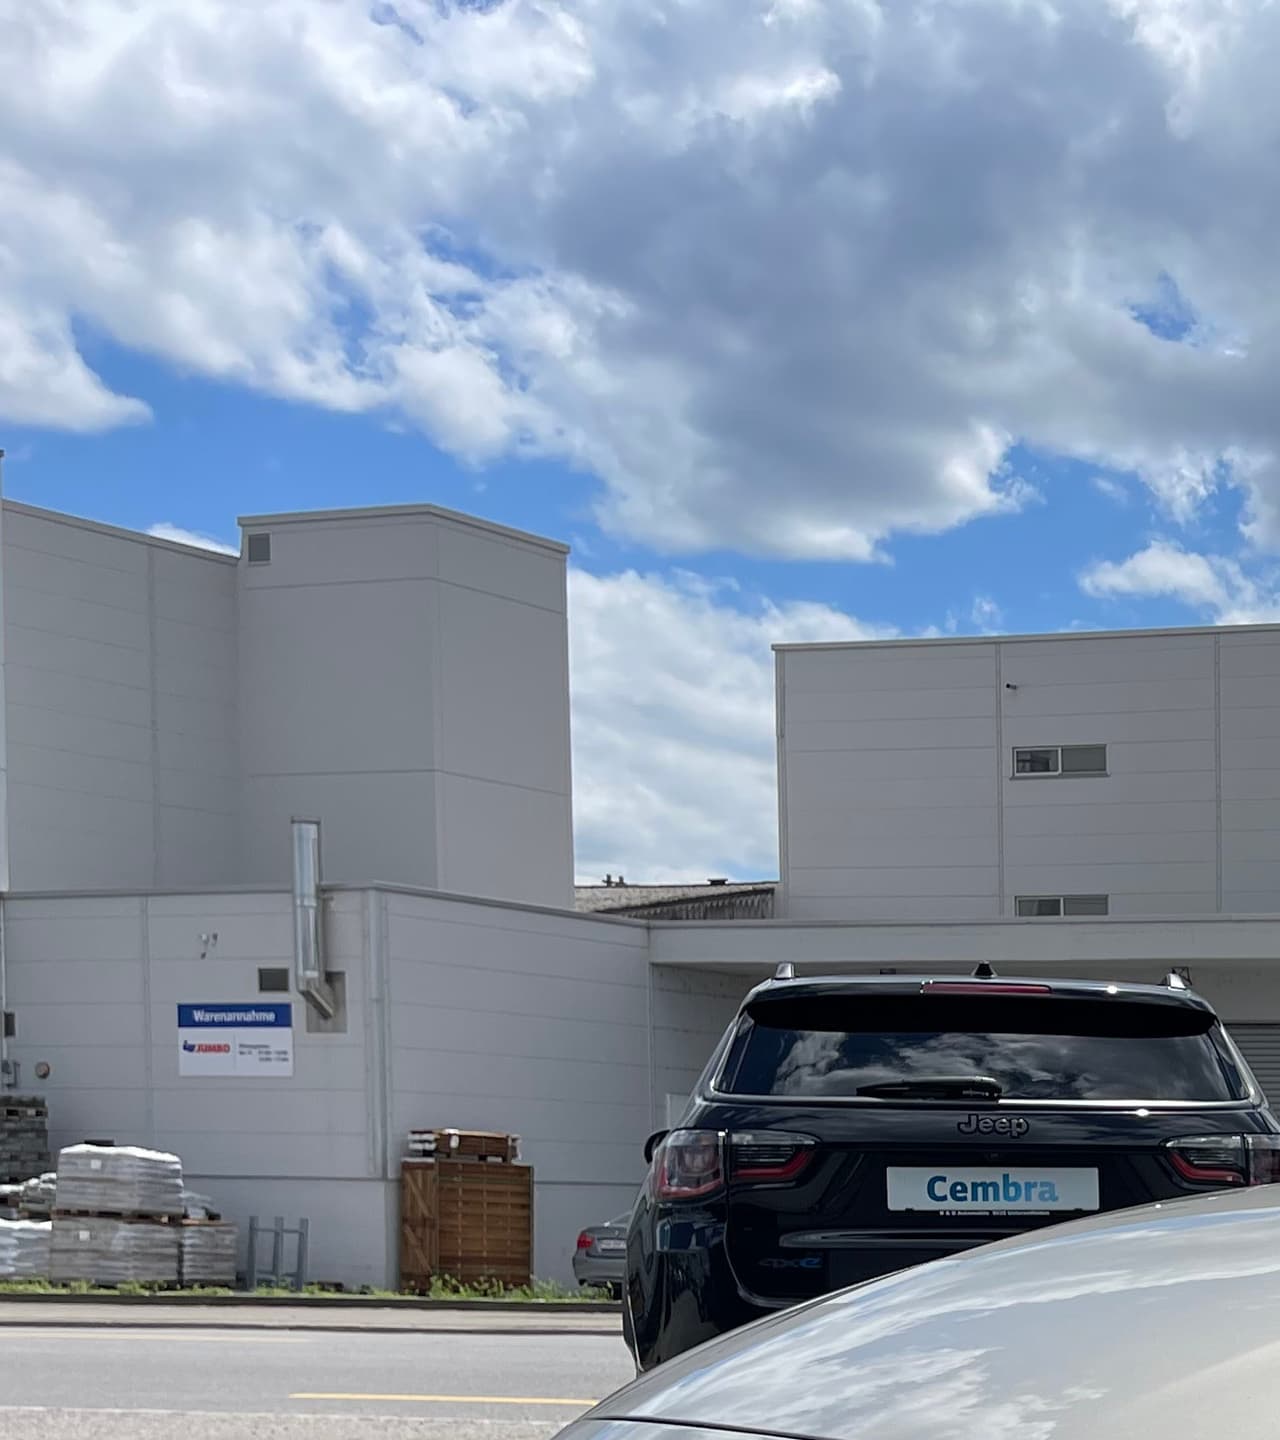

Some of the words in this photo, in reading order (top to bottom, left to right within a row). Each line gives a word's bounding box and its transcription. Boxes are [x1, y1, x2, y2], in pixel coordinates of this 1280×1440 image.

[193, 1009, 276, 1022] Warenannahme
[958, 1114, 1029, 1137] Jeep
[926, 1173, 1059, 1203] Cembra
